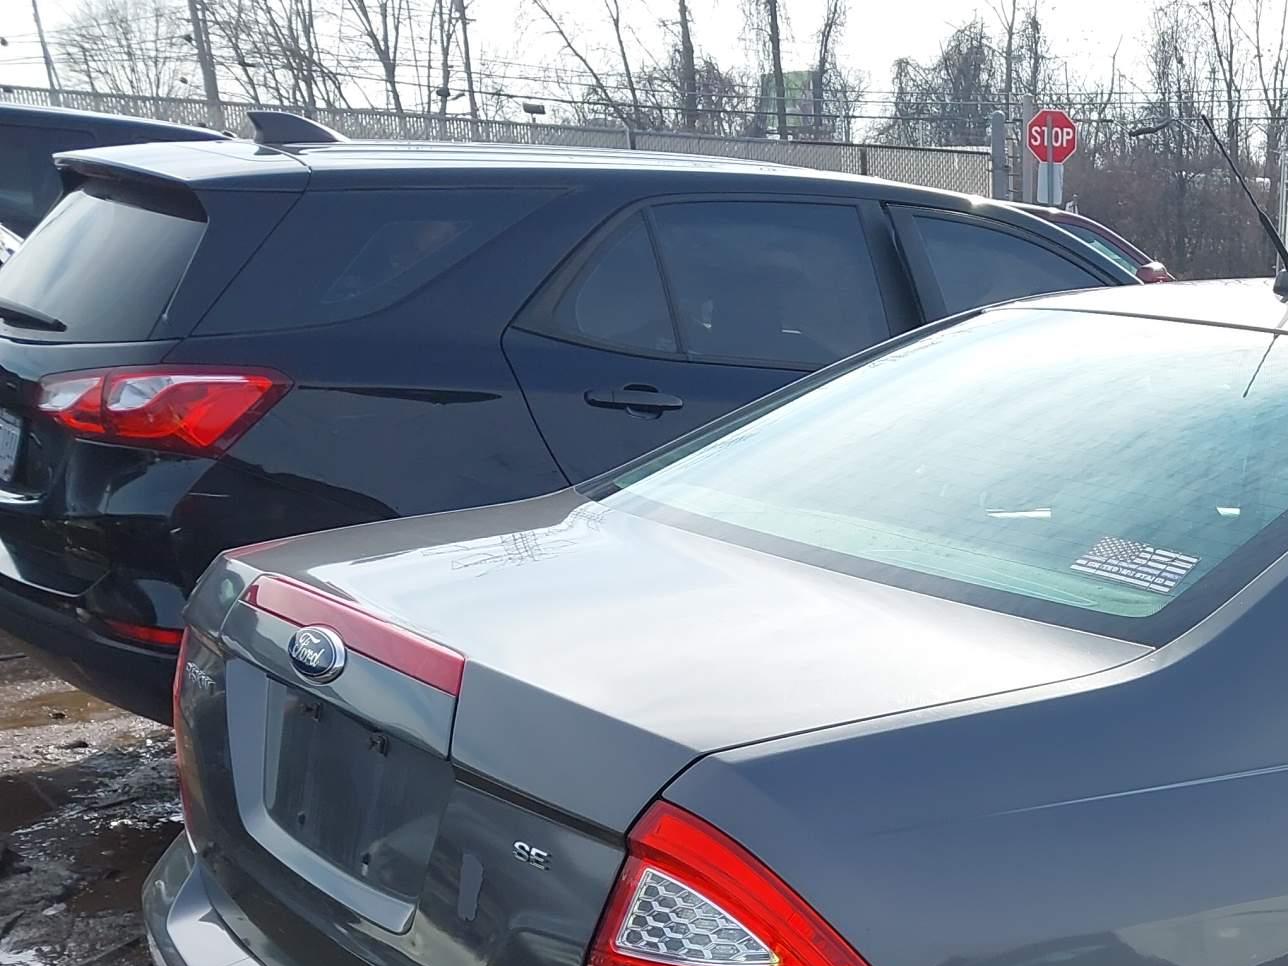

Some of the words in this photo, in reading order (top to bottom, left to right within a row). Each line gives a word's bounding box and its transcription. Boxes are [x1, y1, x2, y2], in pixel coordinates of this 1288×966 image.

[1030, 126, 1073, 148] STOP
[291, 631, 325, 667] Ford
[513, 841, 548, 870] SE
